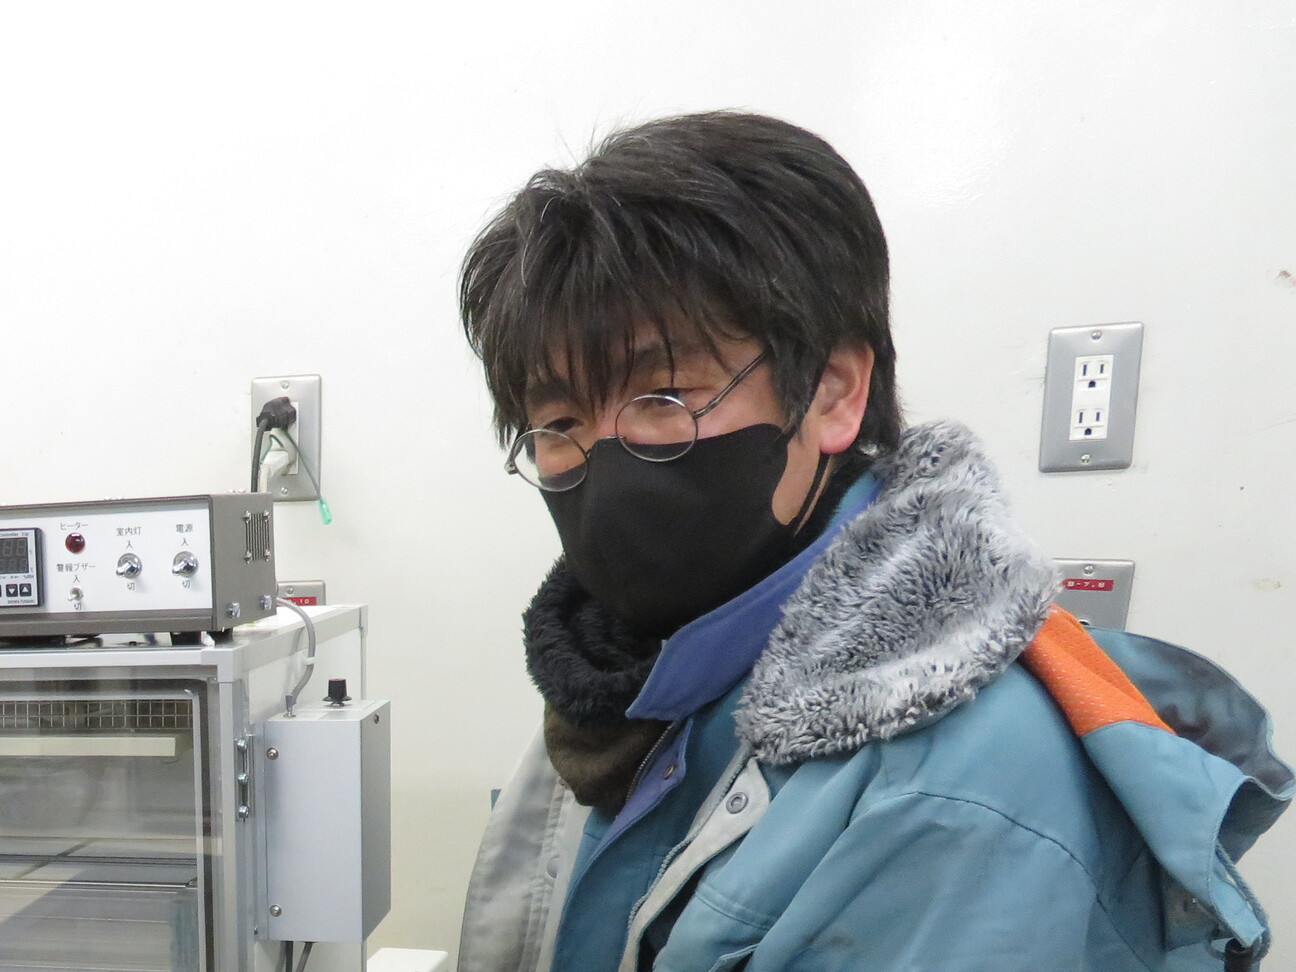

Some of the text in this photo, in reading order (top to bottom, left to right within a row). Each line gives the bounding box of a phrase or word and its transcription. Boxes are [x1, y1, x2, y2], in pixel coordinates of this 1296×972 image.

[59, 521, 89, 531] ヒーター
[175, 523, 194, 533] 電源
[115, 526, 142, 537] 室内灯
[125, 540, 134, 549] 入
[180, 537, 189, 547] 入
[56, 563, 96, 573] 警報ブザー
[72, 574, 81, 583] 入
[126, 582, 136, 591] 切
[181, 580, 191, 589] 切
[73, 602, 83, 611] 切
